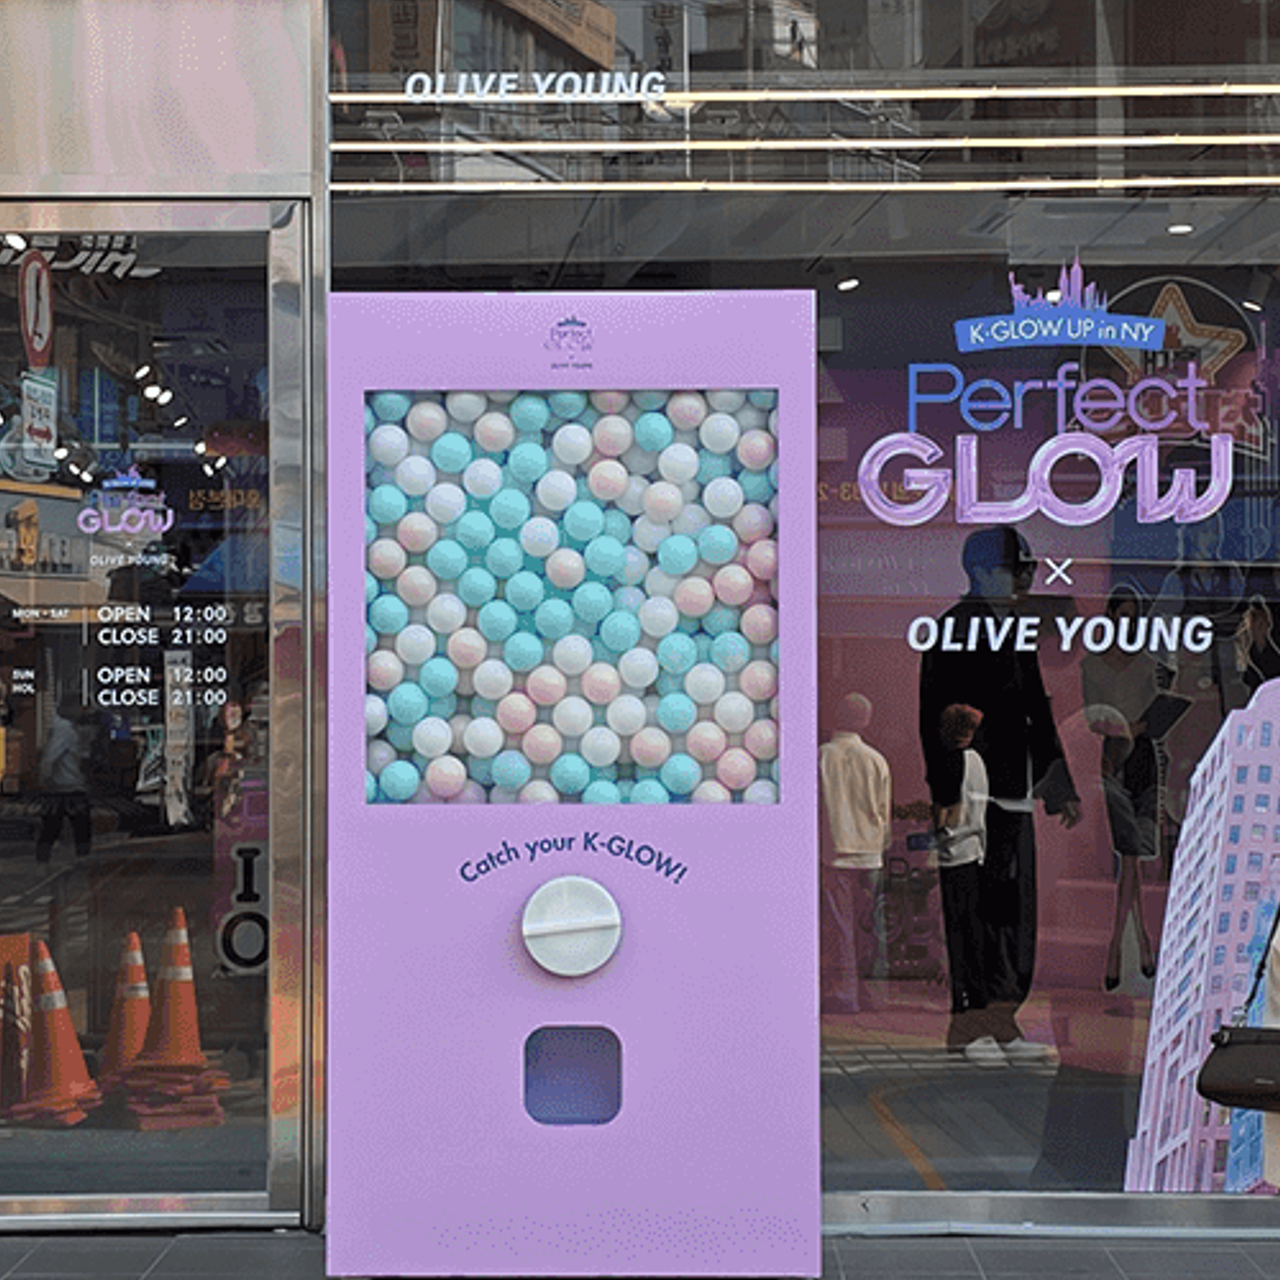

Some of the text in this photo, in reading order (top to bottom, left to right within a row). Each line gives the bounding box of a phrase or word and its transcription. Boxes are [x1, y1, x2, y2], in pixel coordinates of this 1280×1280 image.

[405, 71, 666, 103] OLIVE YOUNG
[1067, 316, 1095, 339] UP
[1098, 320, 1118, 339] in
[1121, 322, 1156, 342] NY
[908, 361, 1210, 433] Perfect
[858, 430, 1233, 527] GLOW
[77, 507, 174, 534] GLOW
[97, 606, 151, 622] OPEN
[173, 606, 228, 622] 12:00
[97, 628, 228, 645] CLOSE 21:00
[907, 616, 1214, 652] OLIVE YOUNG
[97, 667, 228, 683] OPEN 12:00
[97, 689, 228, 706] CLOSE 21:00
[459, 831, 688, 884] Catch your K-GLOW!
